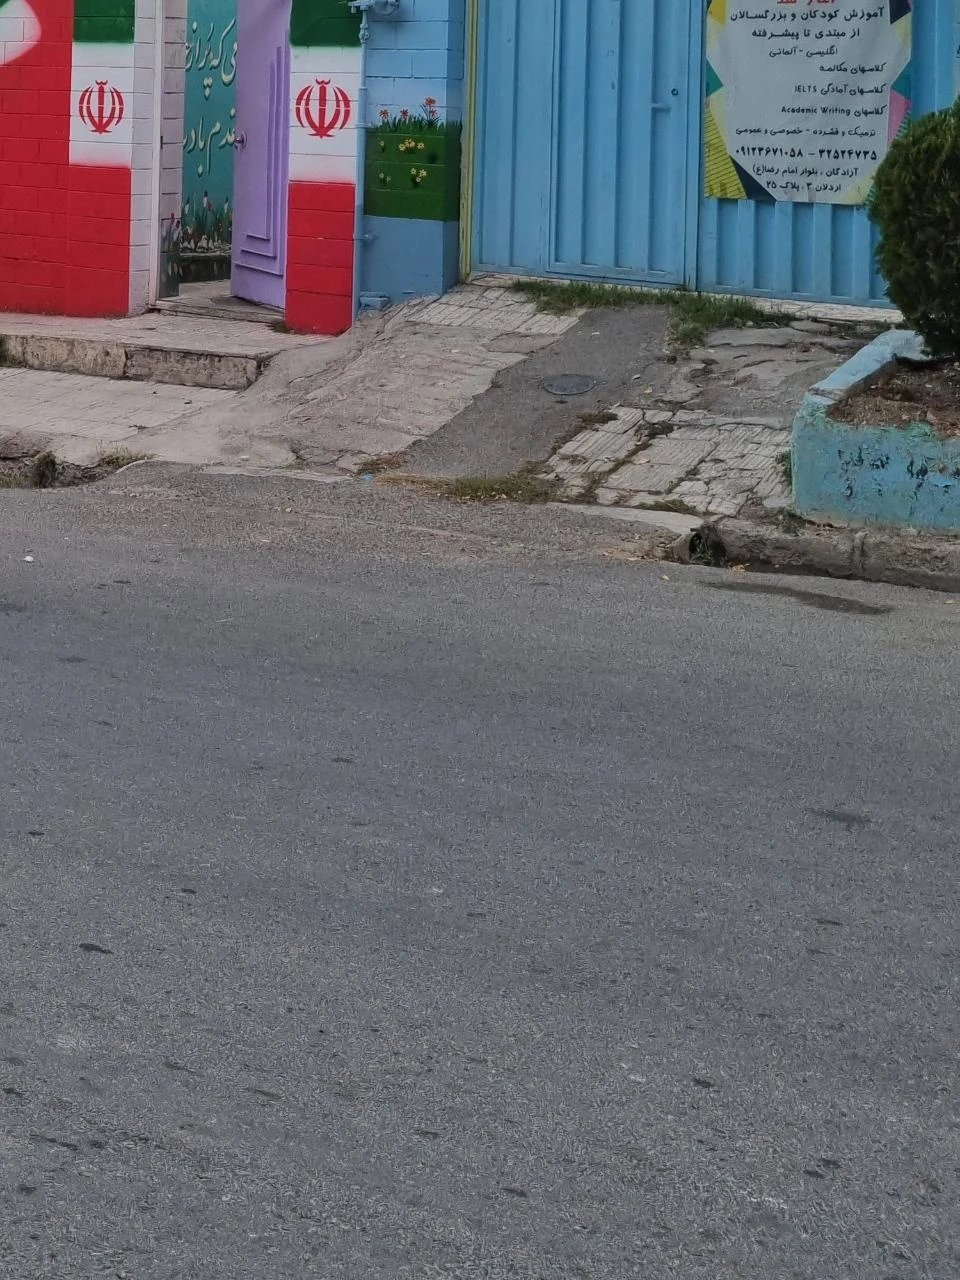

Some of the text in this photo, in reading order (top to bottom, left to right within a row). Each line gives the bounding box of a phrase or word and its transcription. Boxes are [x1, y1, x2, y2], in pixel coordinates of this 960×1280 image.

[730, 8, 787, 22] بزرگسالان
[800, 8, 840, 21] کودکان
[844, 6, 884, 22] آموزش
[752, 28, 860, 40] از مبتدی تا پیشرفته
[769, 46, 797, 58] آلمانی
[806, 45, 838, 57] انگلیسی
[819, 61, 887, 75] کلاسهای مکالمه
[795, 82, 887, 96] کلاسهای آمادگی IELTS
[781, 104, 887, 117] کلاسهای Academic Writing
[736, 128, 762, 136] عمومی
[770, 127, 803, 136] خصوصی
[813, 128, 839, 136] فشرده
[848, 125, 876, 138] ترمیک
[783, 167, 798, 177] امام
[826, 168, 858, 177] آزادگان
[779, 181, 800, 193] پلاک
